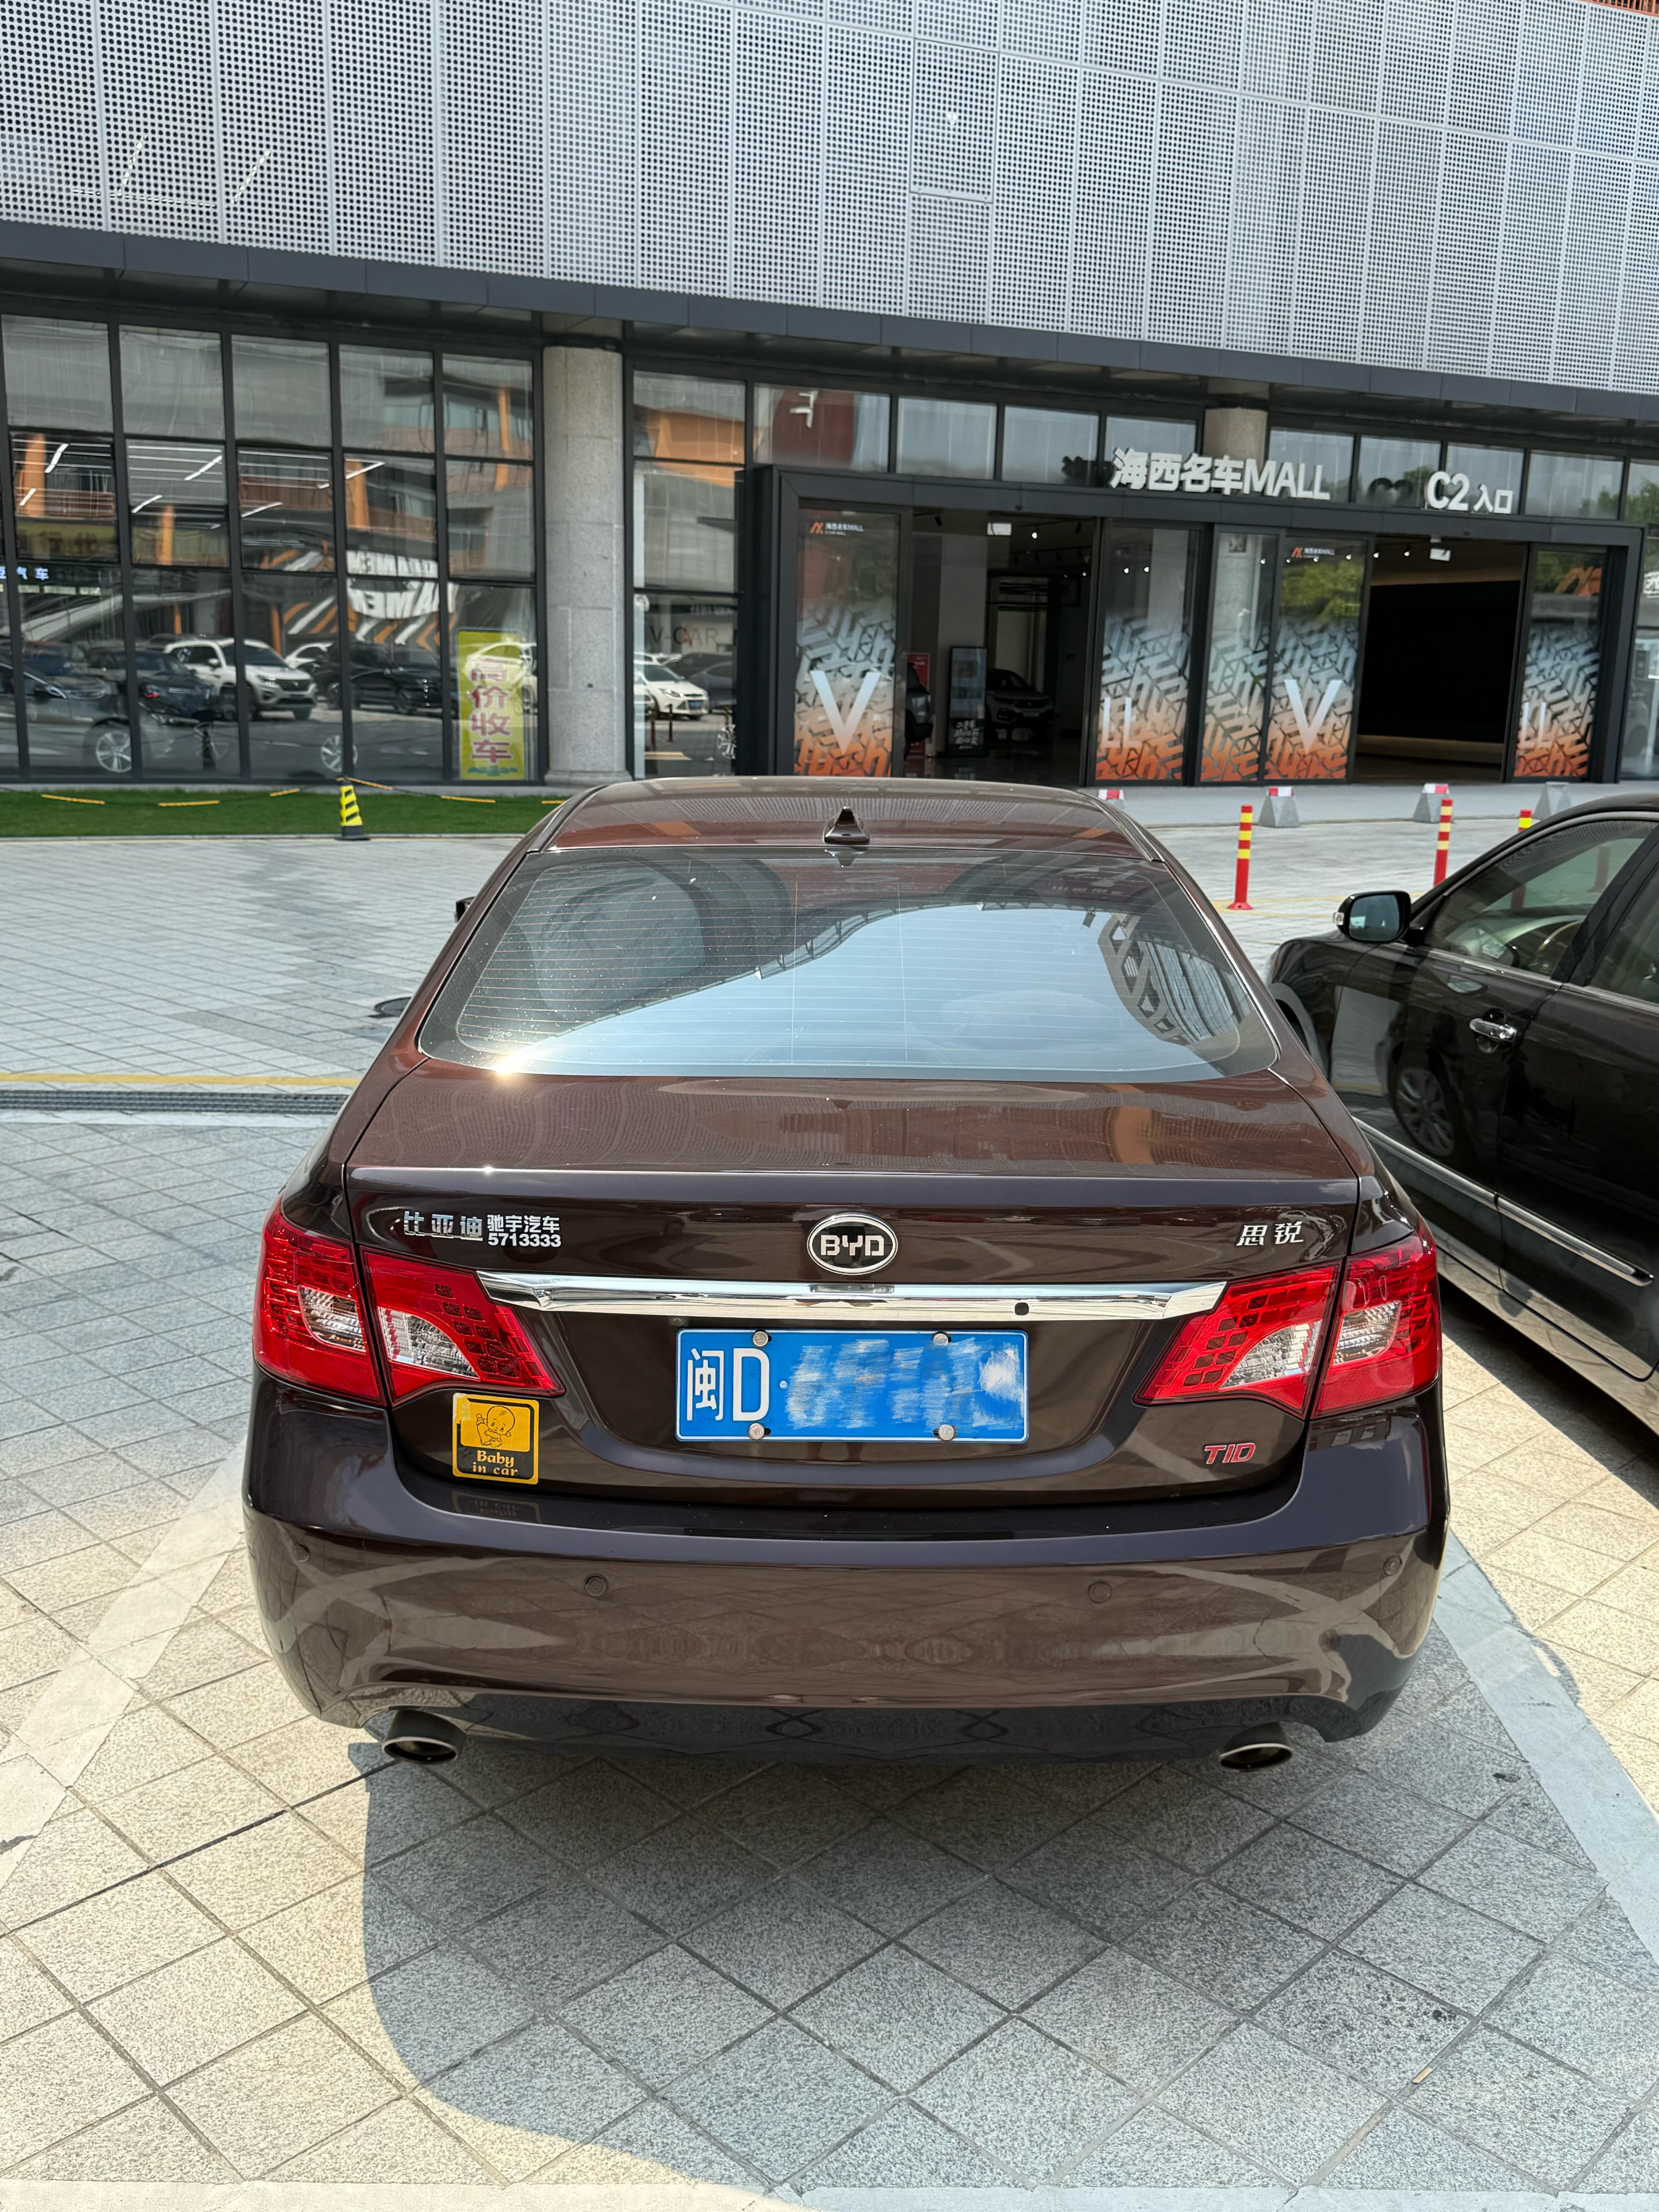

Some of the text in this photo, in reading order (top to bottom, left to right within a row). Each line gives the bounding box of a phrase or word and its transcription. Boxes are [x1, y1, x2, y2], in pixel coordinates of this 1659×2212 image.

[1109, 447, 1330, 500] 海西名车MALL
[1425, 471, 1513, 514] C2 入口
[404, 1211, 483, 1241] 比亚迪
[487, 1214, 560, 1233] 驰宇汽车
[1236, 1221, 1304, 1246] 思锐
[488, 1233, 562, 1247] 5713333
[820, 1235, 884, 1256] BYD
[477, 1450, 514, 1467] Baby
[1204, 1443, 1256, 1464] TID
[472, 1462, 518, 1476] in car
